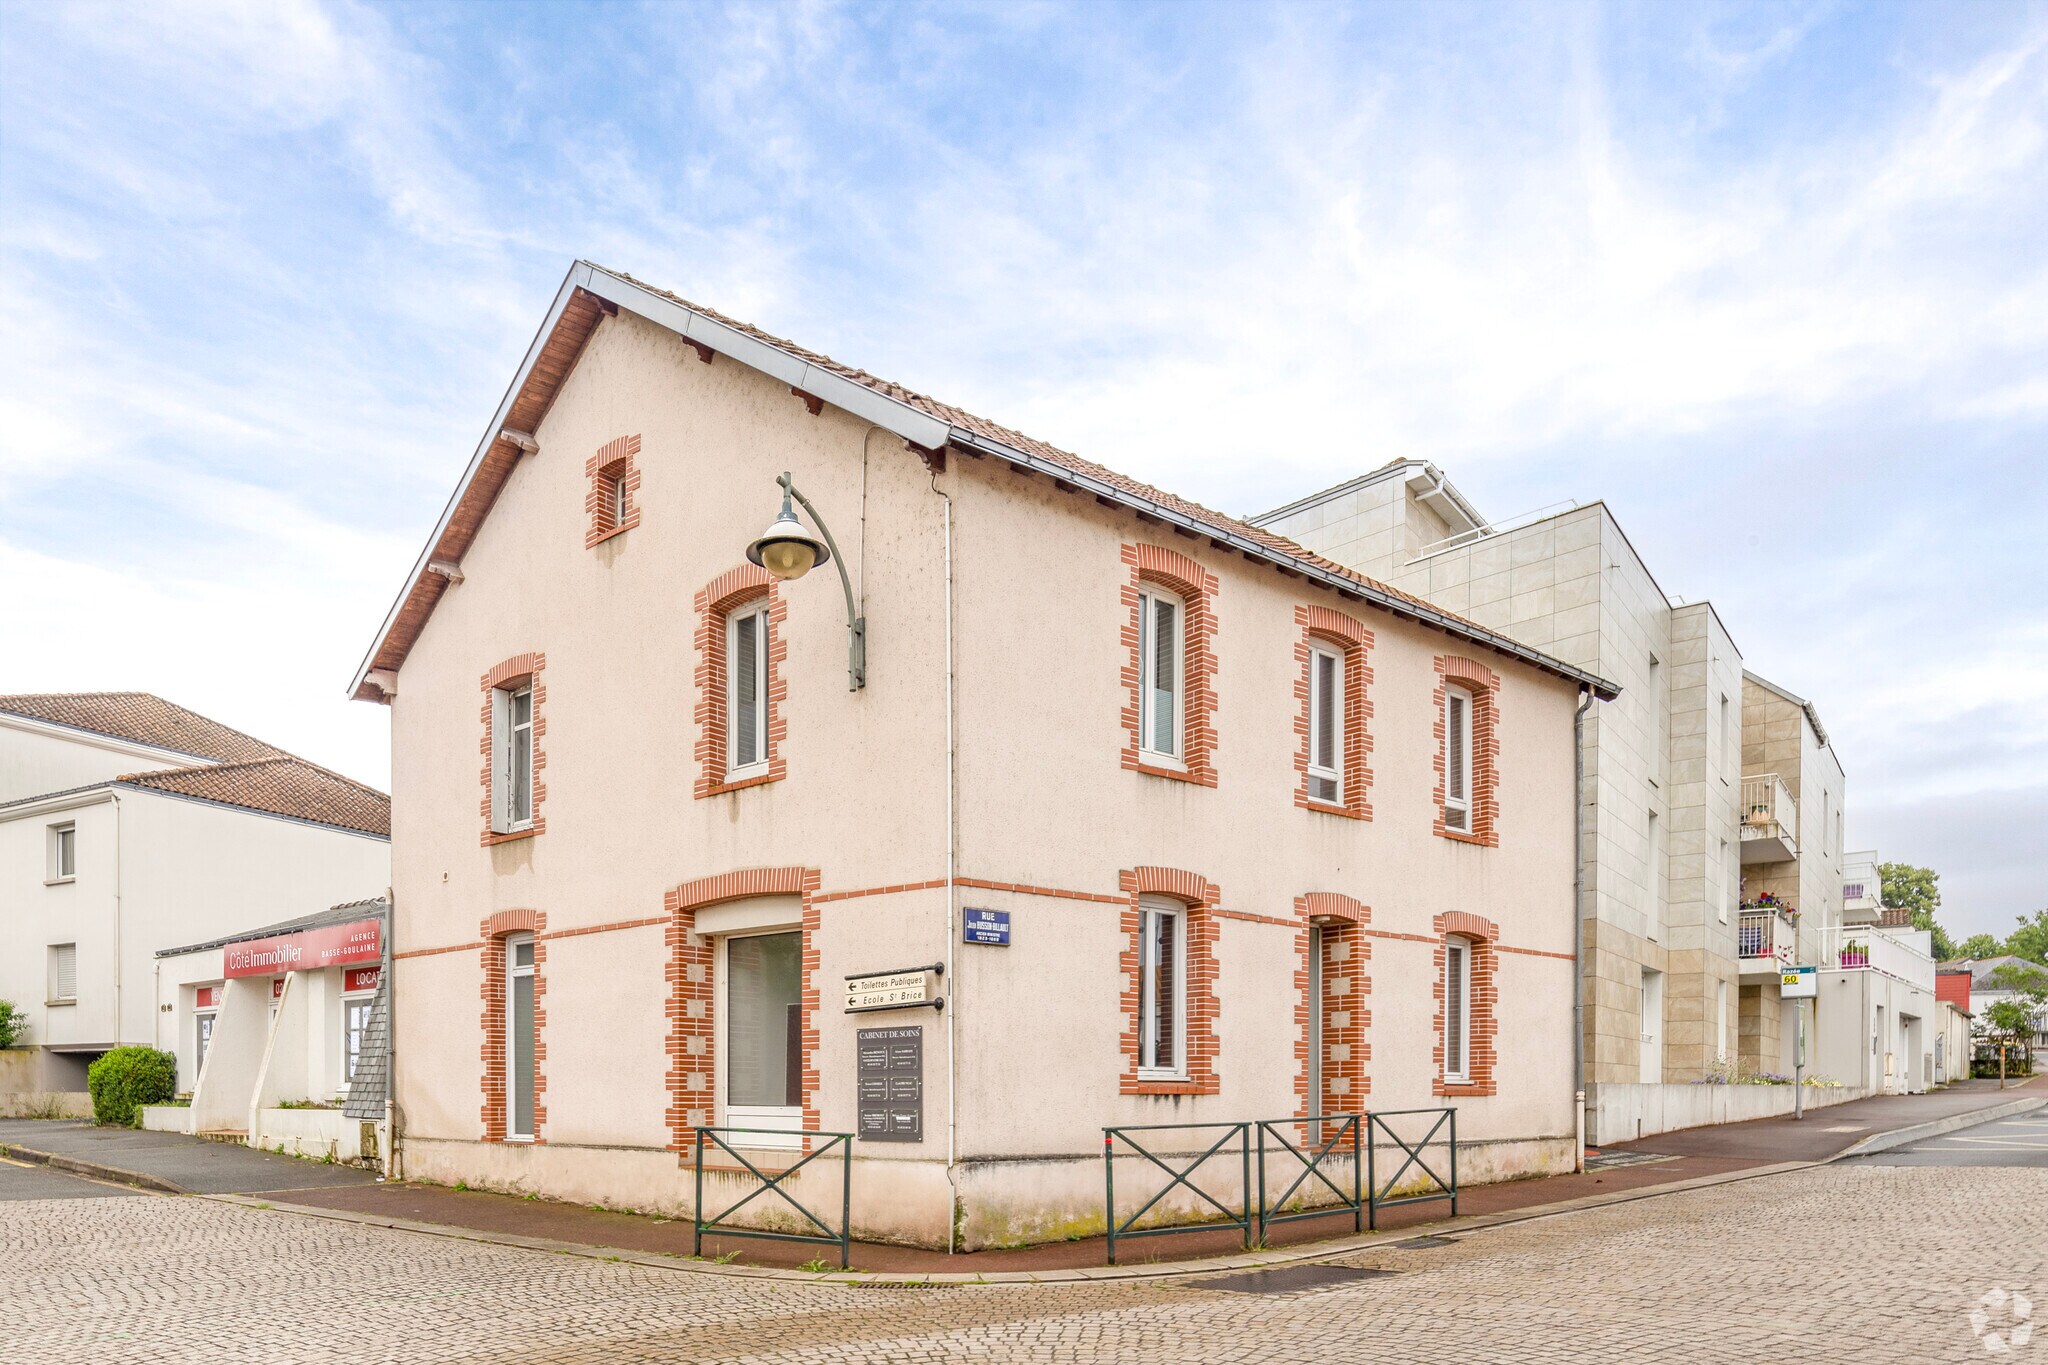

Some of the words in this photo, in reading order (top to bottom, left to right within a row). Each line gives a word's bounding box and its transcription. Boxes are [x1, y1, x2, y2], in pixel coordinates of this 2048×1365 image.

[981, 911, 995, 921] RUE
[351, 931, 375, 942] AGENCE
[322, 943, 375, 957] BASSE-GOULAINE
[230, 950, 249, 969] Côté
[251, 945, 302, 967] Immobilier
[861, 980, 888, 990] Toilettes
[890, 976, 923, 987] Publiques
[1784, 975, 1797, 983] 60
[863, 995, 884, 1004] Ecole
[901, 991, 922, 1000] Brice
[860, 1031, 888, 1040] CABINET
[890, 1030, 899, 1038] DE
[900, 1029, 920, 1038] SOINS
